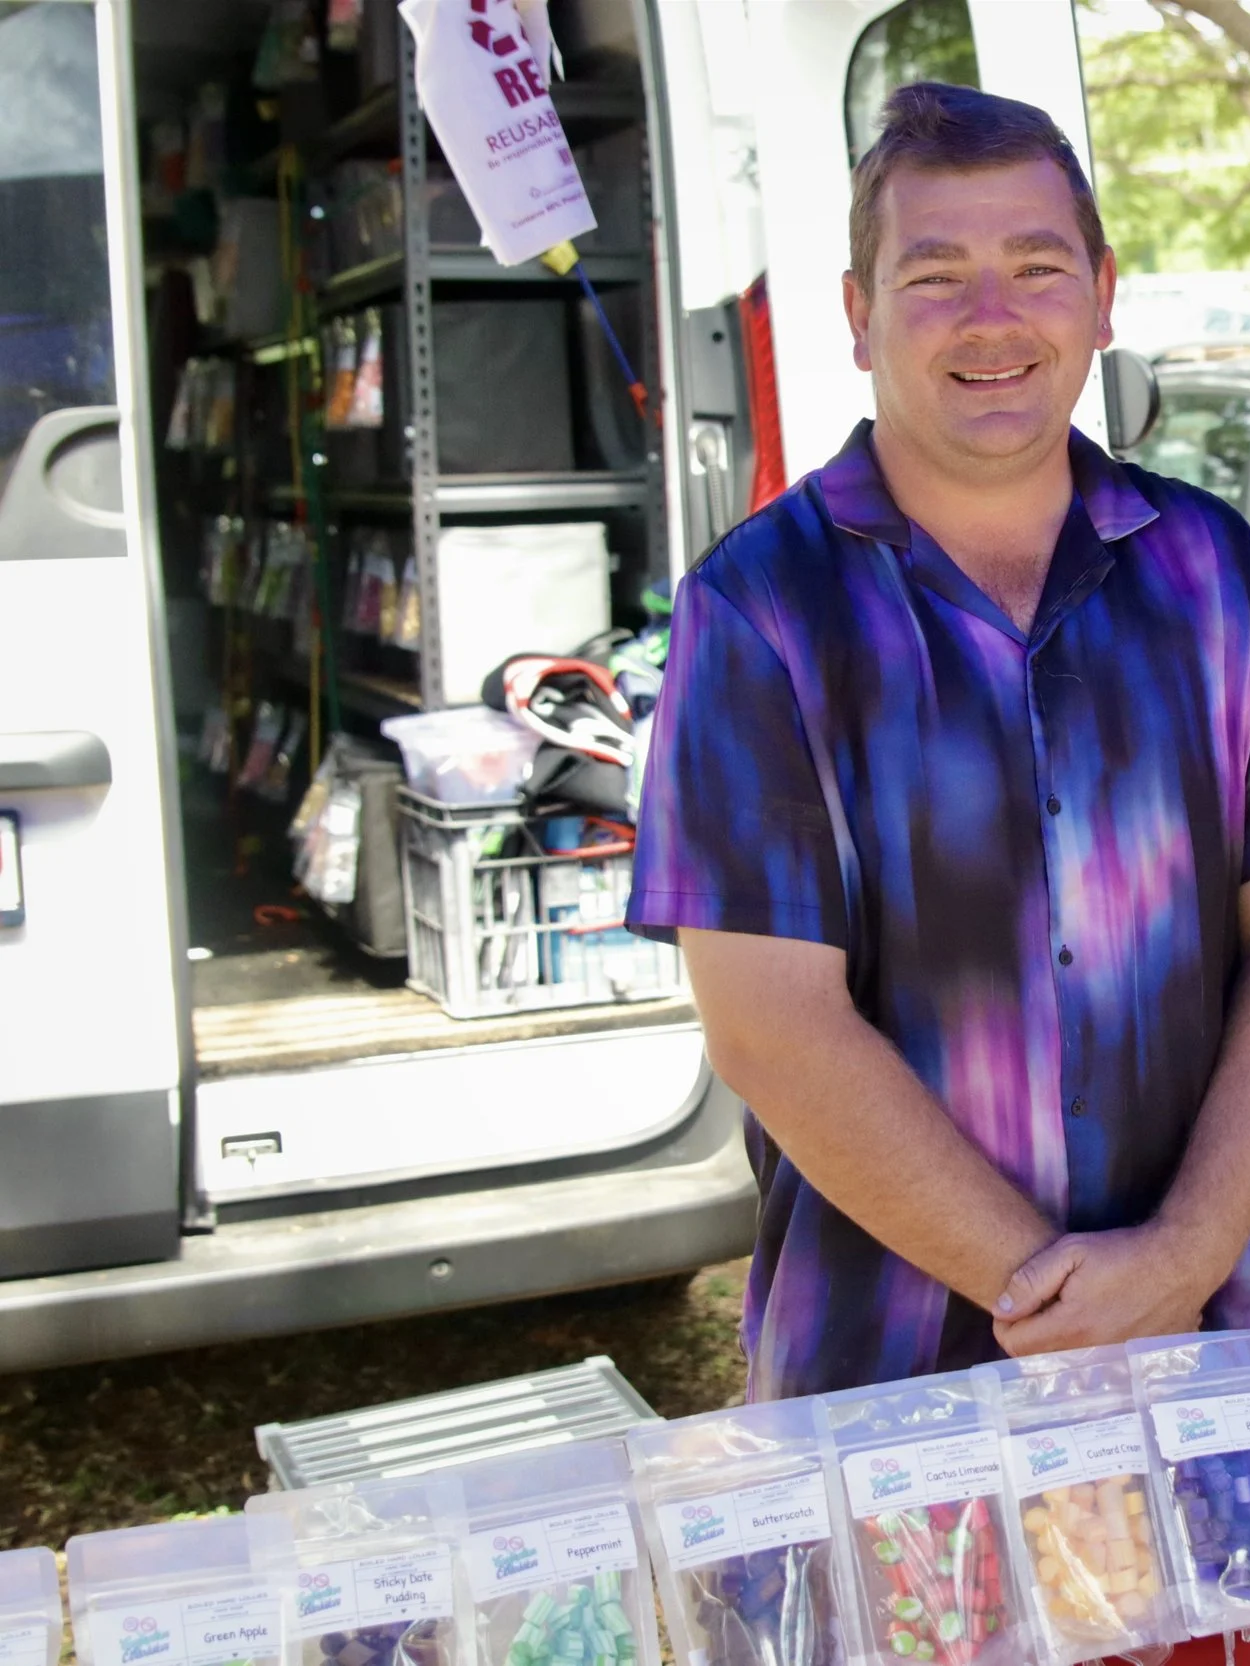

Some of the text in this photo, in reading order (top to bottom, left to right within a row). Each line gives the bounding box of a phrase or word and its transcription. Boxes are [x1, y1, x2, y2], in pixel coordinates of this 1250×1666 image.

[1086, 1445, 1119, 1459] Custard
[926, 1469, 957, 1482] Cactus
[752, 1506, 815, 1528] Butterscotch
[567, 1539, 623, 1559] Peppermint
[374, 1571, 434, 1590] Sticky Date
[385, 1591, 426, 1604] Pudding
[203, 1625, 269, 1644] Green Apple
